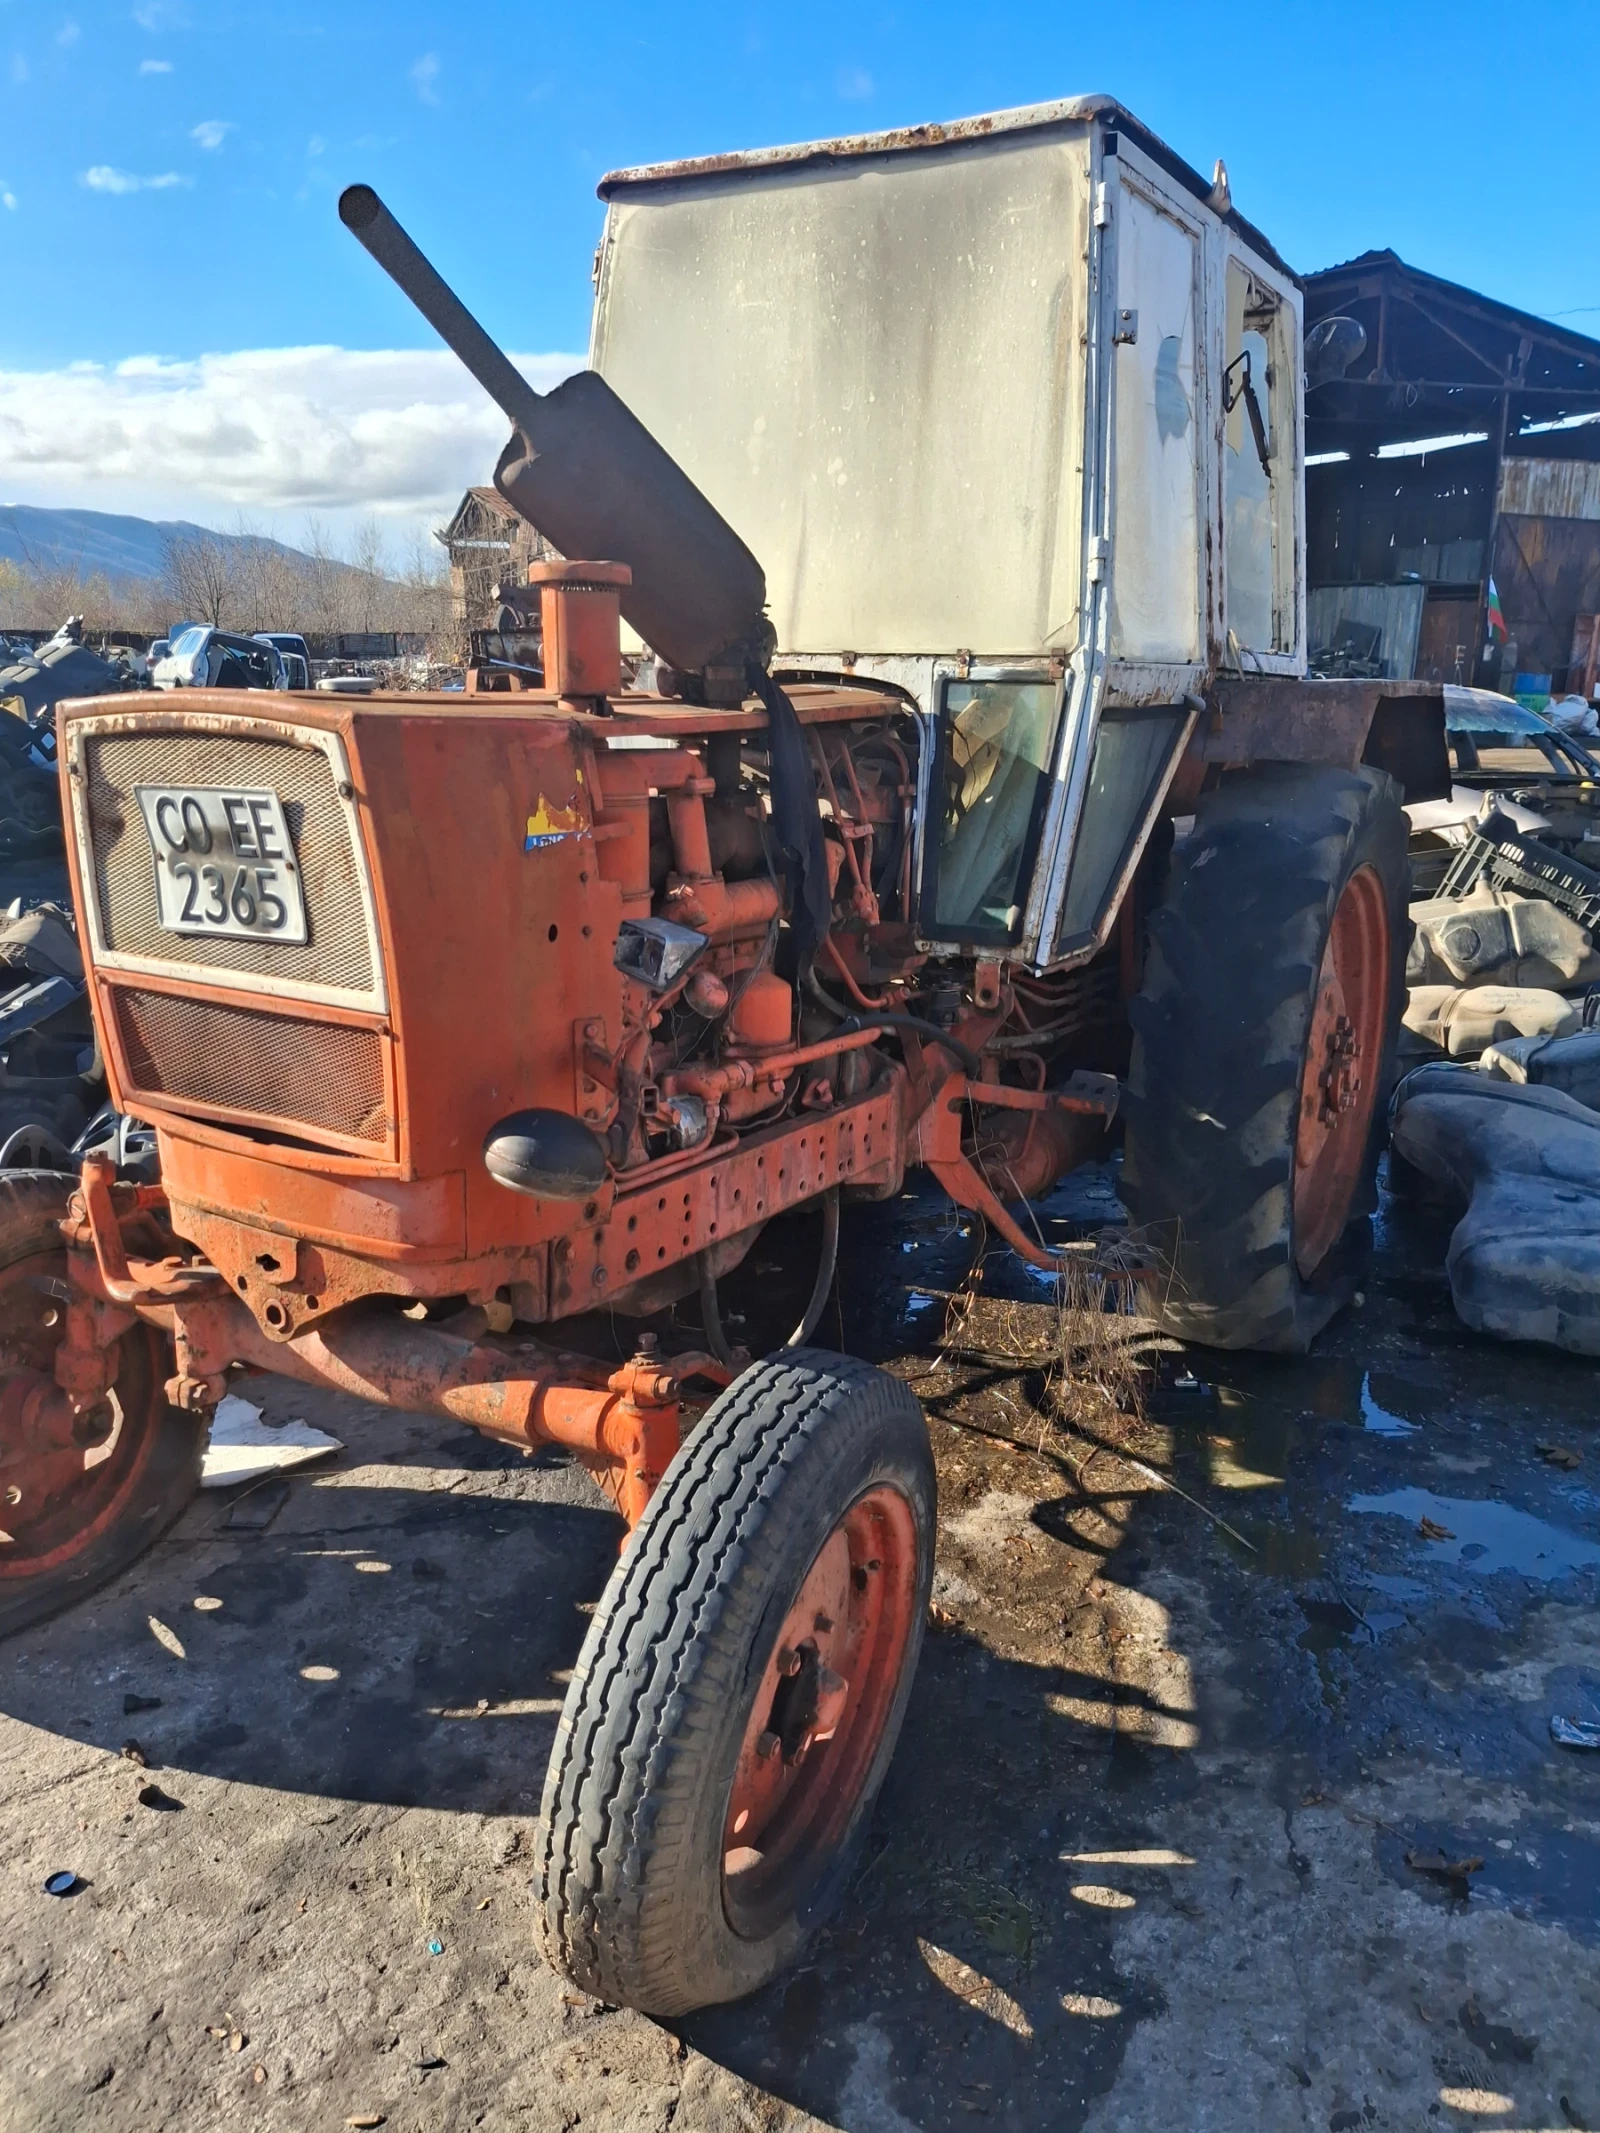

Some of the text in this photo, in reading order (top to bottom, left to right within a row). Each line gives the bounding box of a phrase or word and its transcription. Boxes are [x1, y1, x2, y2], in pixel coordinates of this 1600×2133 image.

[155, 796, 283, 859] CO EE
[174, 862, 288, 929] 2365
